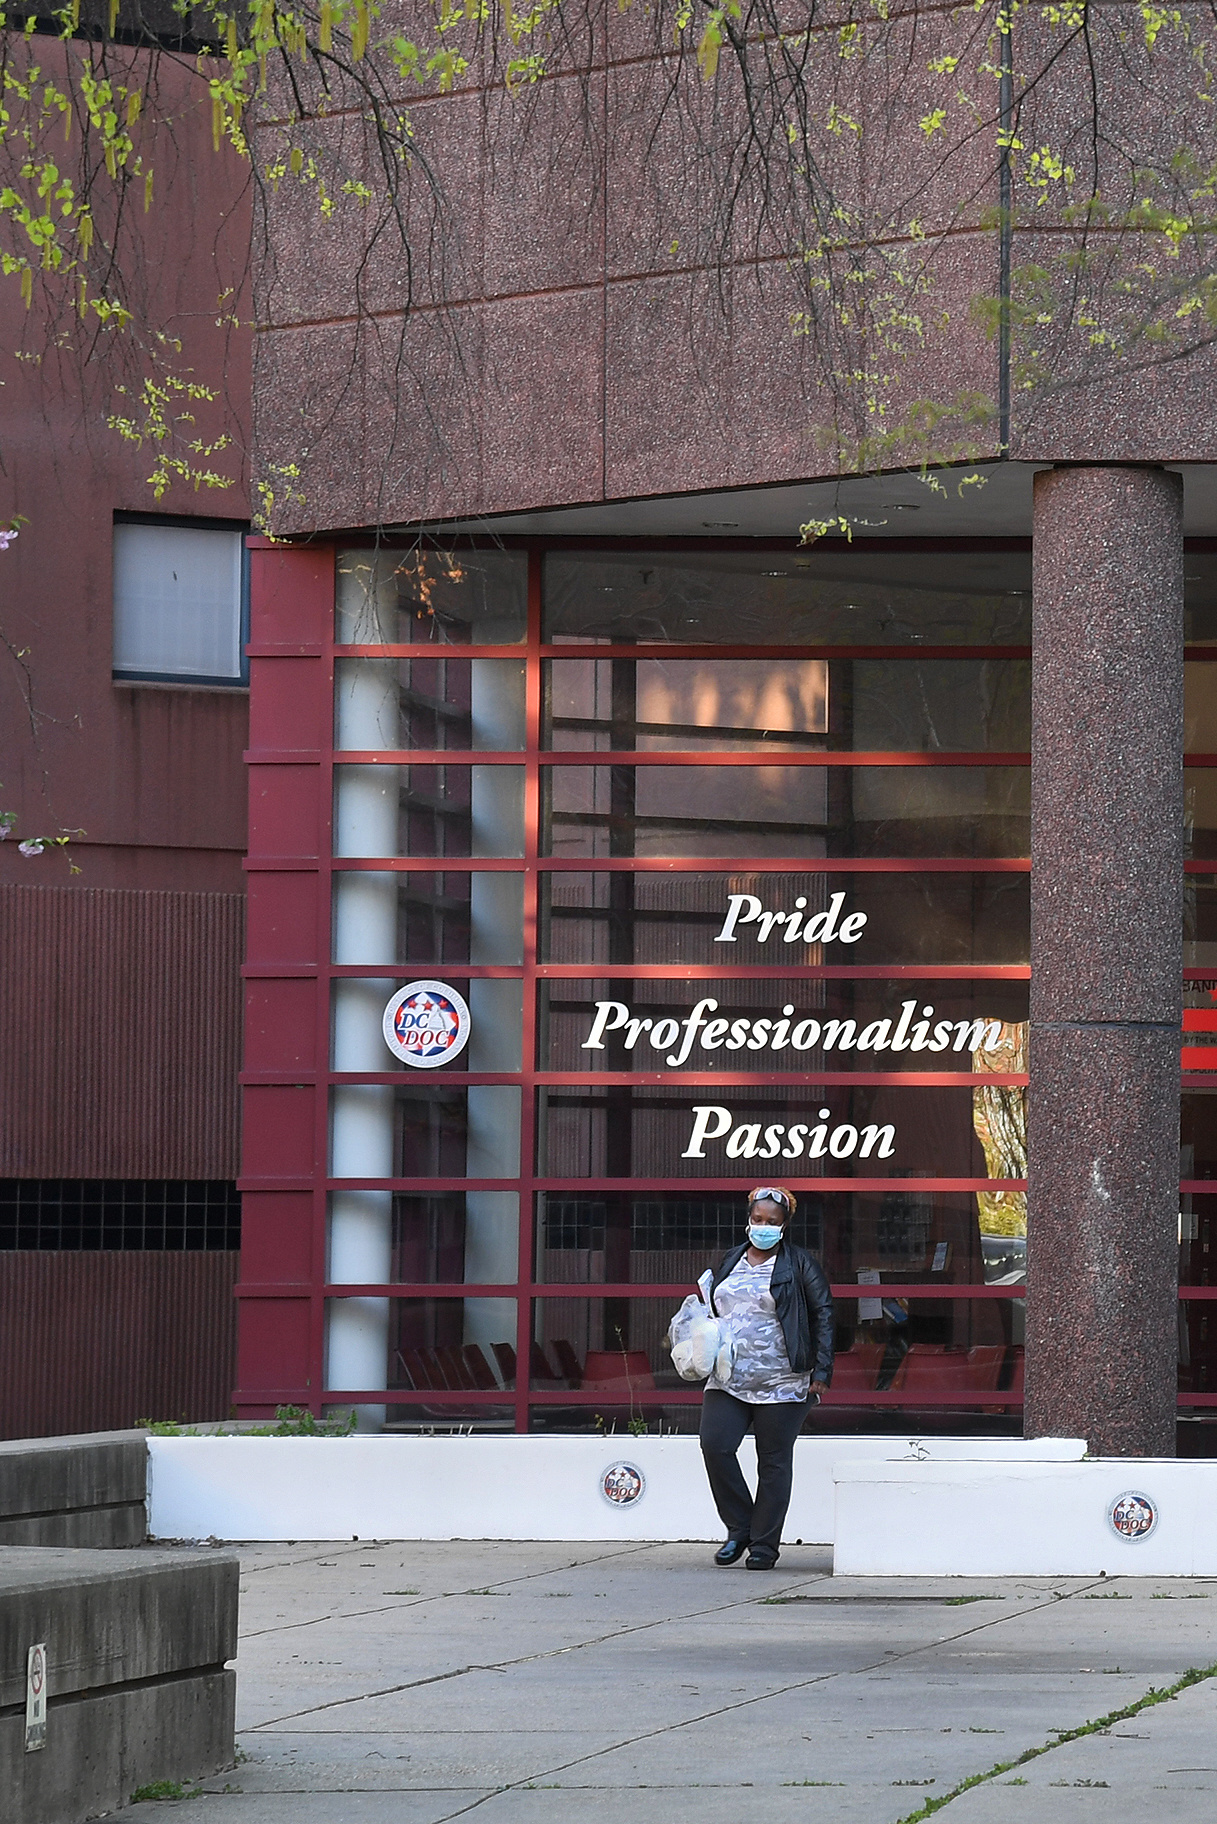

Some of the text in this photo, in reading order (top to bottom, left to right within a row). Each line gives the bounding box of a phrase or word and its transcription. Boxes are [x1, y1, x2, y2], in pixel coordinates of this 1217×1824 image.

[714, 891, 868, 944] Pride
[400, 1013, 430, 1029] DC
[404, 1030, 450, 1046] DOC
[581, 998, 1004, 1067] Professionalism
[681, 1106, 896, 1159] Passion
[606, 1479, 625, 1488] DC
[610, 1488, 638, 1497] DOC
[1116, 1510, 1135, 1521] DC
[1121, 1519, 1150, 1531] DOC
